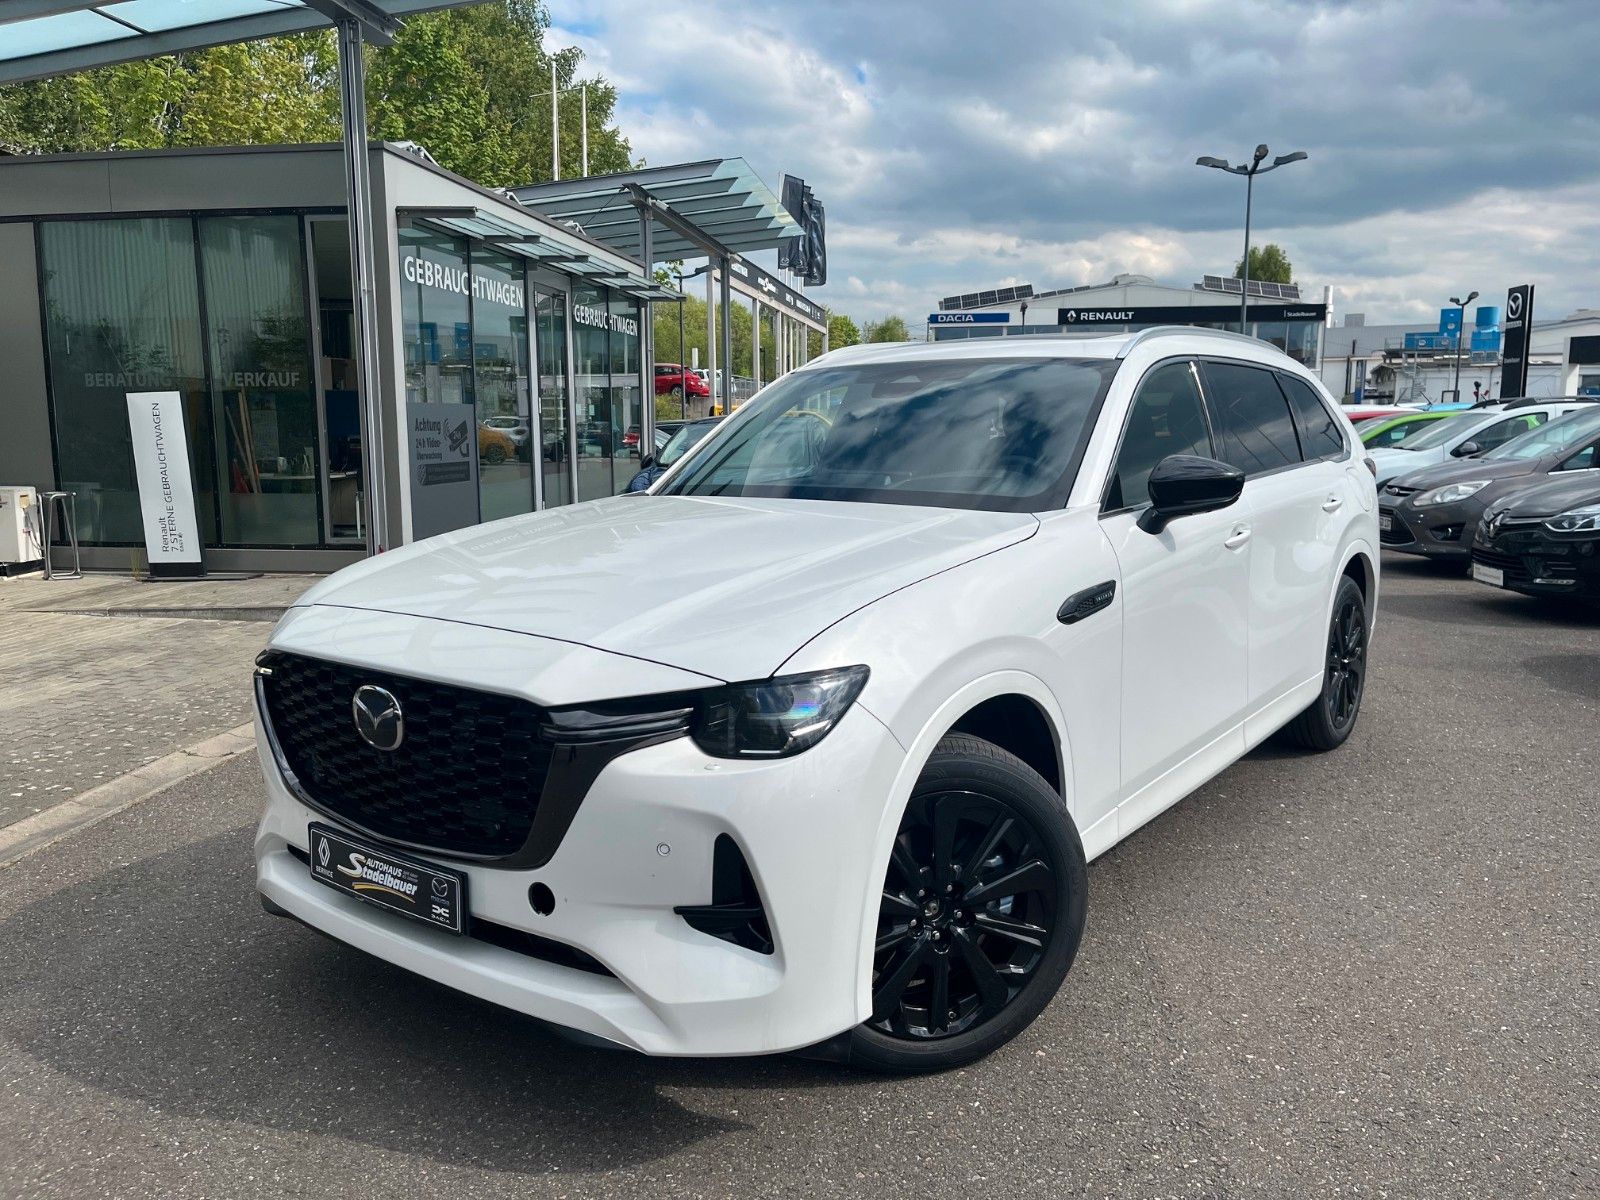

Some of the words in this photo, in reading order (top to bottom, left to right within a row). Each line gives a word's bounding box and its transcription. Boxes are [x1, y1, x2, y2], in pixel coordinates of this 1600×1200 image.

[404, 255, 524, 308] GEBRAUCHTWAGEN
[574, 304, 638, 337] GEBRAUCHTWAGEN
[938, 314, 974, 323] DACIA
[1080, 311, 1135, 321] RENAULT
[85, 372, 173, 388] BERATUNG
[224, 372, 300, 387] VERKAUF
[415, 418, 441, 434] Achtung
[151, 402, 174, 502] GEBRAUCHTWAGEN
[159, 516, 169, 552] Renault
[166, 505, 177, 544] STERNE
[171, 544, 179, 552] 7
[337, 853, 418, 896] Stadelbauer
[365, 858, 403, 877] AUTOHAUS
